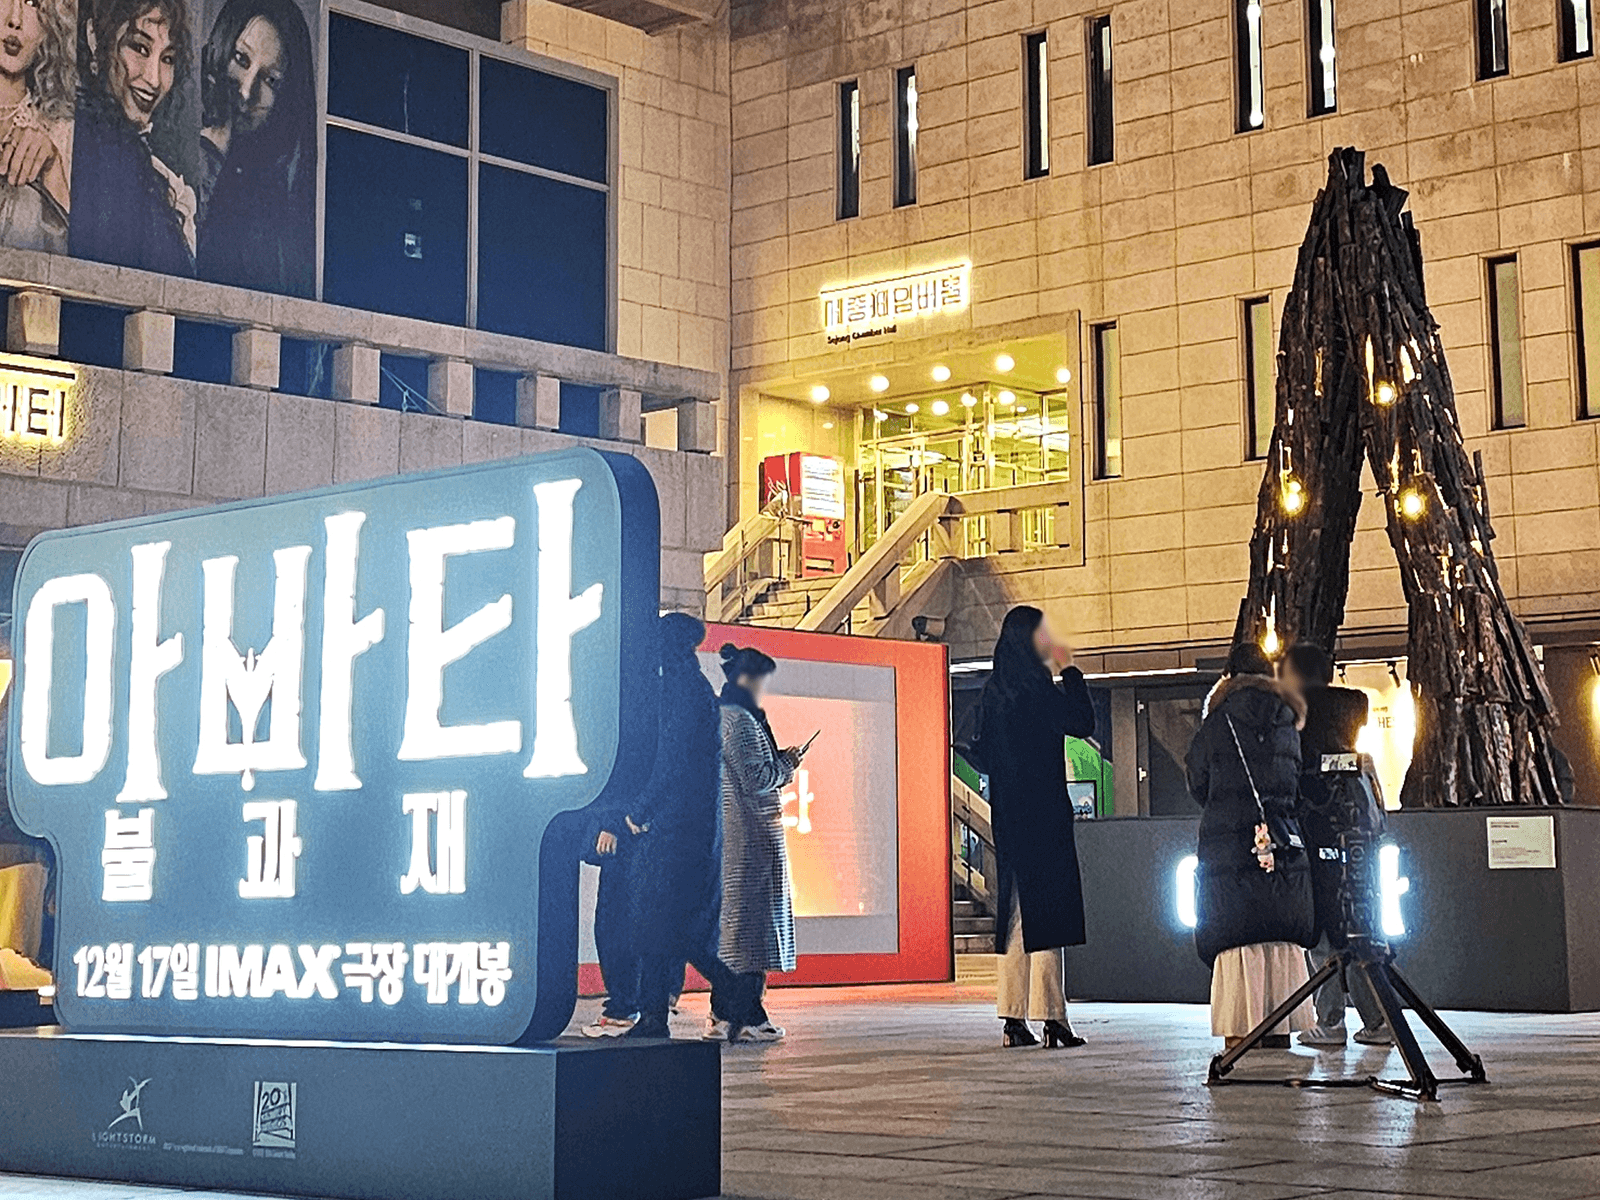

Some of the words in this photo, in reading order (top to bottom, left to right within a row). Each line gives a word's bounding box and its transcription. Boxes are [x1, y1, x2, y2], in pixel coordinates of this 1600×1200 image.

[20, 478, 604, 803] 아바타
[101, 807, 156, 902] 불
[238, 799, 302, 899] 과
[400, 790, 468, 895] 재
[73, 942, 133, 1000] 12월
[137, 942, 199, 1000] 17일
[204, 943, 341, 999] IMAX
[341, 941, 409, 1006] 극장
[413, 941, 512, 1007] 대개봉
[92, 1131, 157, 1145] LIGHTSTORM
